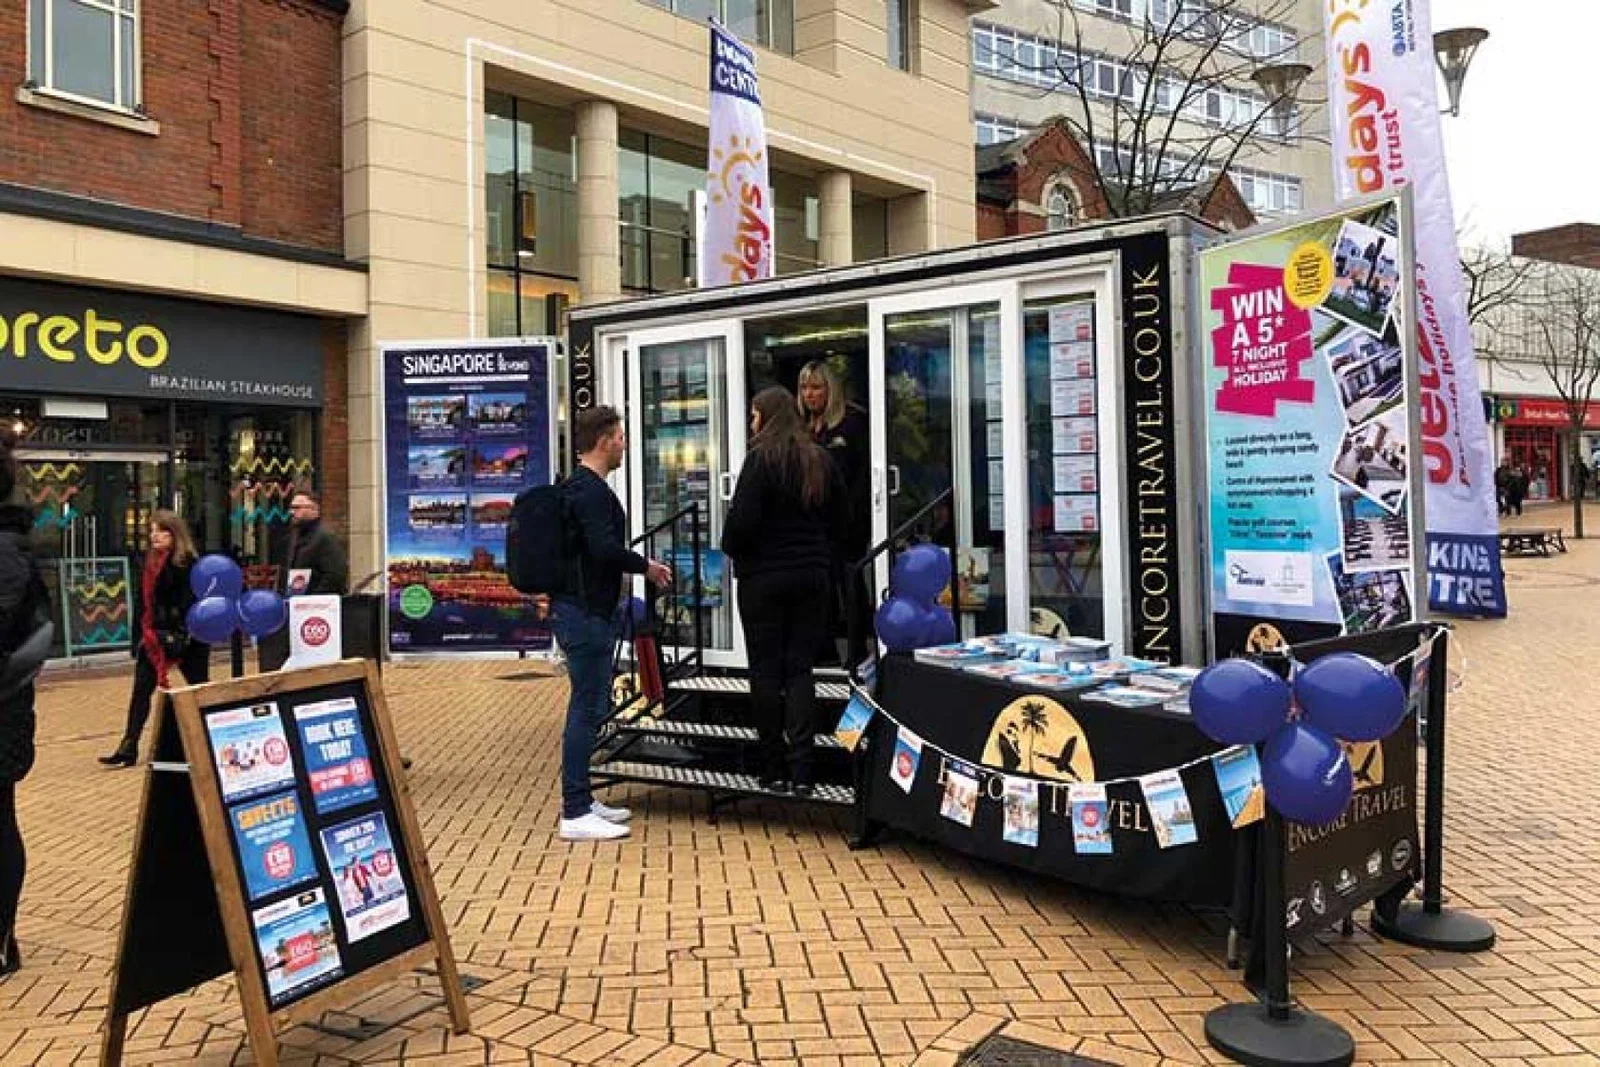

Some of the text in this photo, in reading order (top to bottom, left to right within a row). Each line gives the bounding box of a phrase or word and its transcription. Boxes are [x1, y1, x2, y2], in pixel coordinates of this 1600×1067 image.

[1343, 42, 1386, 194] days
[1381, 108, 1404, 172] trust
[1231, 287, 1284, 321] WIN
[0, 309, 169, 368] reto
[1232, 322, 1250, 348] A
[1242, 343, 1287, 362] NIGHT
[150, 374, 313, 399] BRAZILIAN STEAKHOUSE
[574, 341, 591, 408] O.UK
[1233, 371, 1287, 387] HOLIDAY
[1427, 572, 1497, 608] TRE
[1351, 784, 1409, 824] TRAVEL
